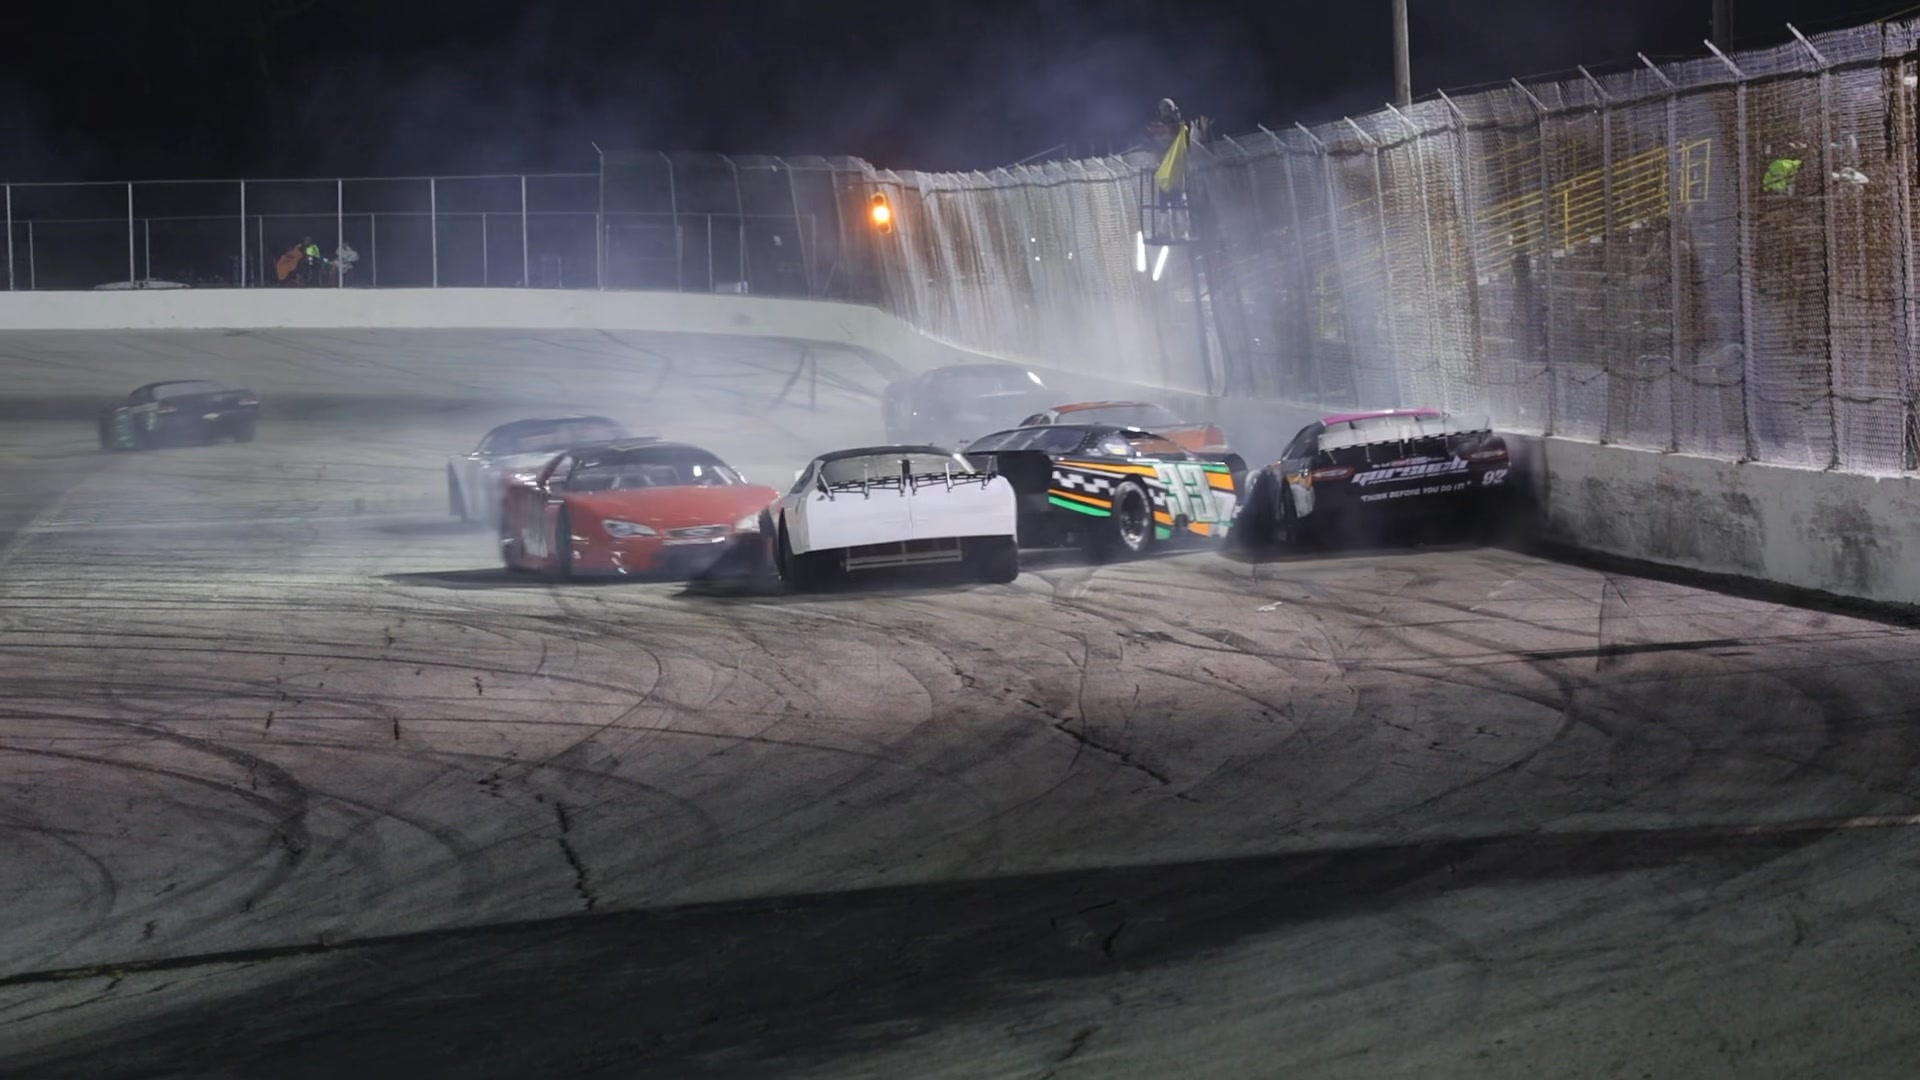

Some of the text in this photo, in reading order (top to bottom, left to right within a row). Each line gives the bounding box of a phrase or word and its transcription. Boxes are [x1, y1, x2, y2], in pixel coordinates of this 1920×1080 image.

[1481, 469, 1508, 486] 92
[1389, 488, 1421, 498] BEFORE
[1422, 486, 1440, 495] YOU
[1440, 484, 1453, 493] DO
